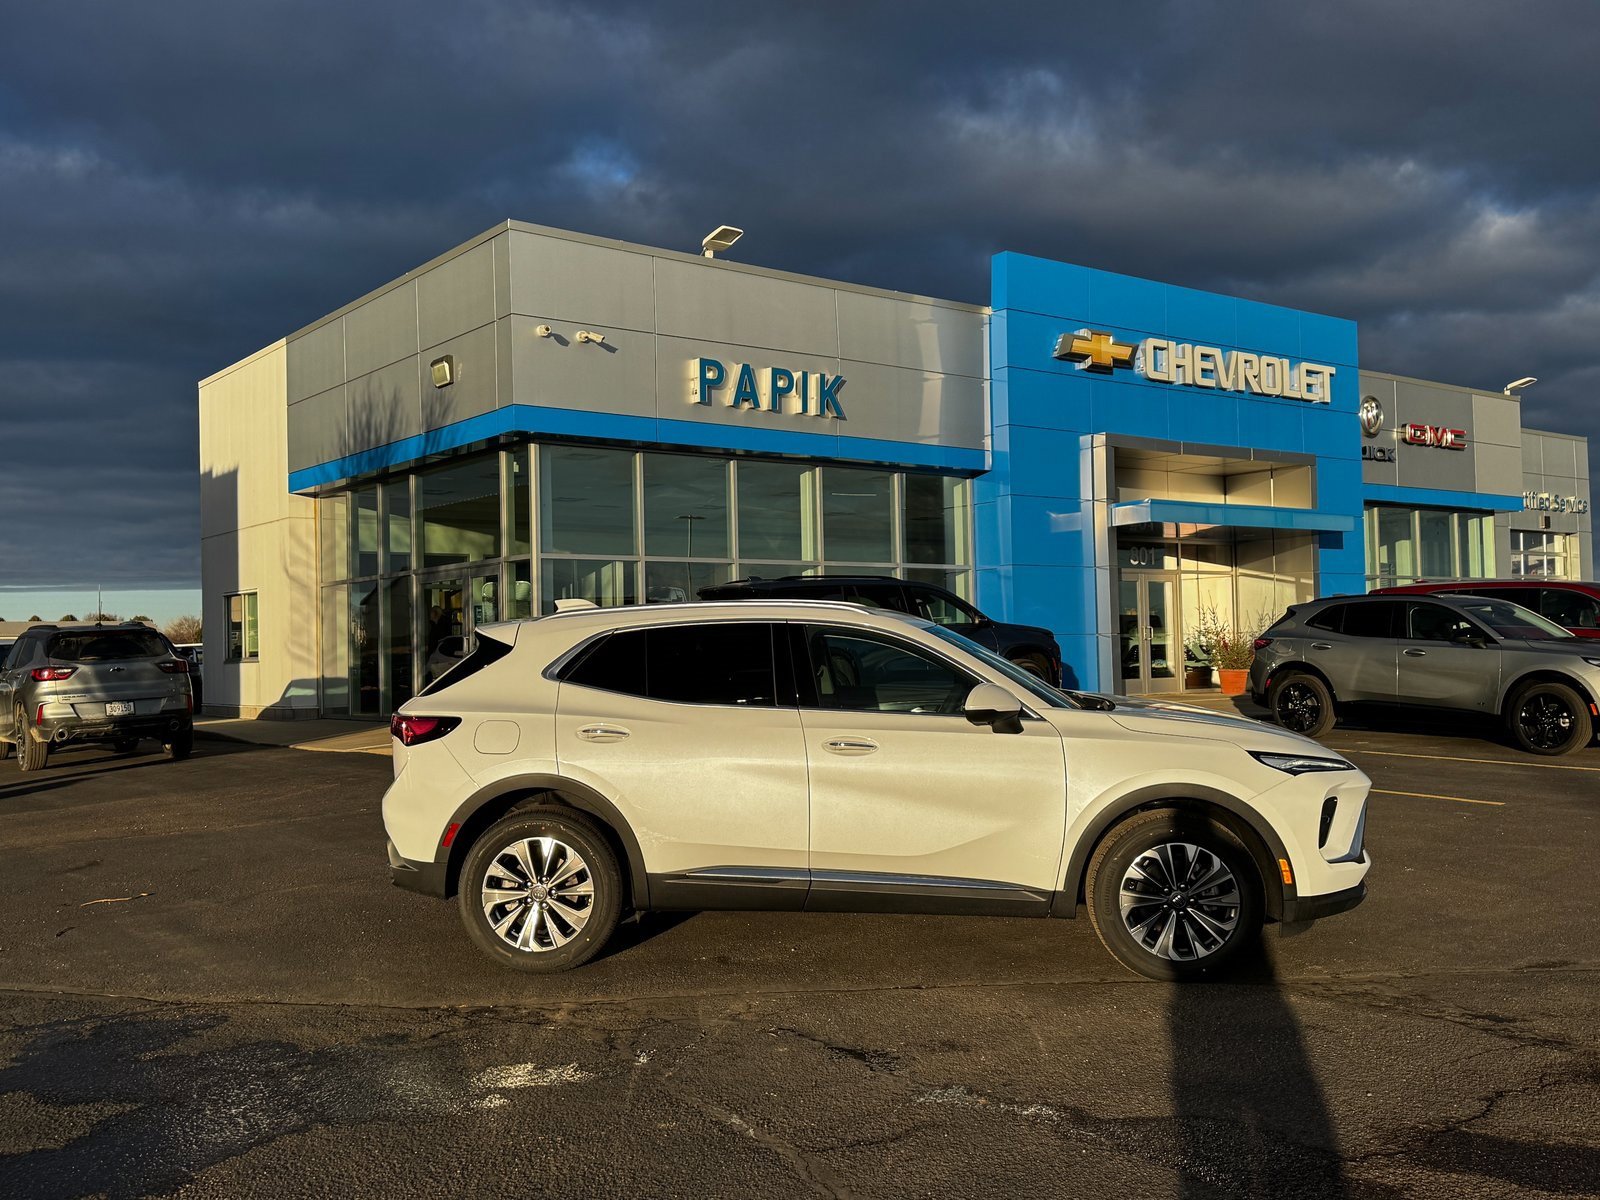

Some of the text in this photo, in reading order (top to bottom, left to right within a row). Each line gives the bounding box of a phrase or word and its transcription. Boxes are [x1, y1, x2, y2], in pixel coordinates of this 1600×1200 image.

[1142, 337, 1336, 403] CHEVROLET
[694, 357, 846, 419] PAPIK
[1404, 423, 1467, 450] GMC
[1362, 446, 1396, 463] UICK
[1523, 491, 1588, 514] tified Service
[1130, 546, 1155, 566] 801
